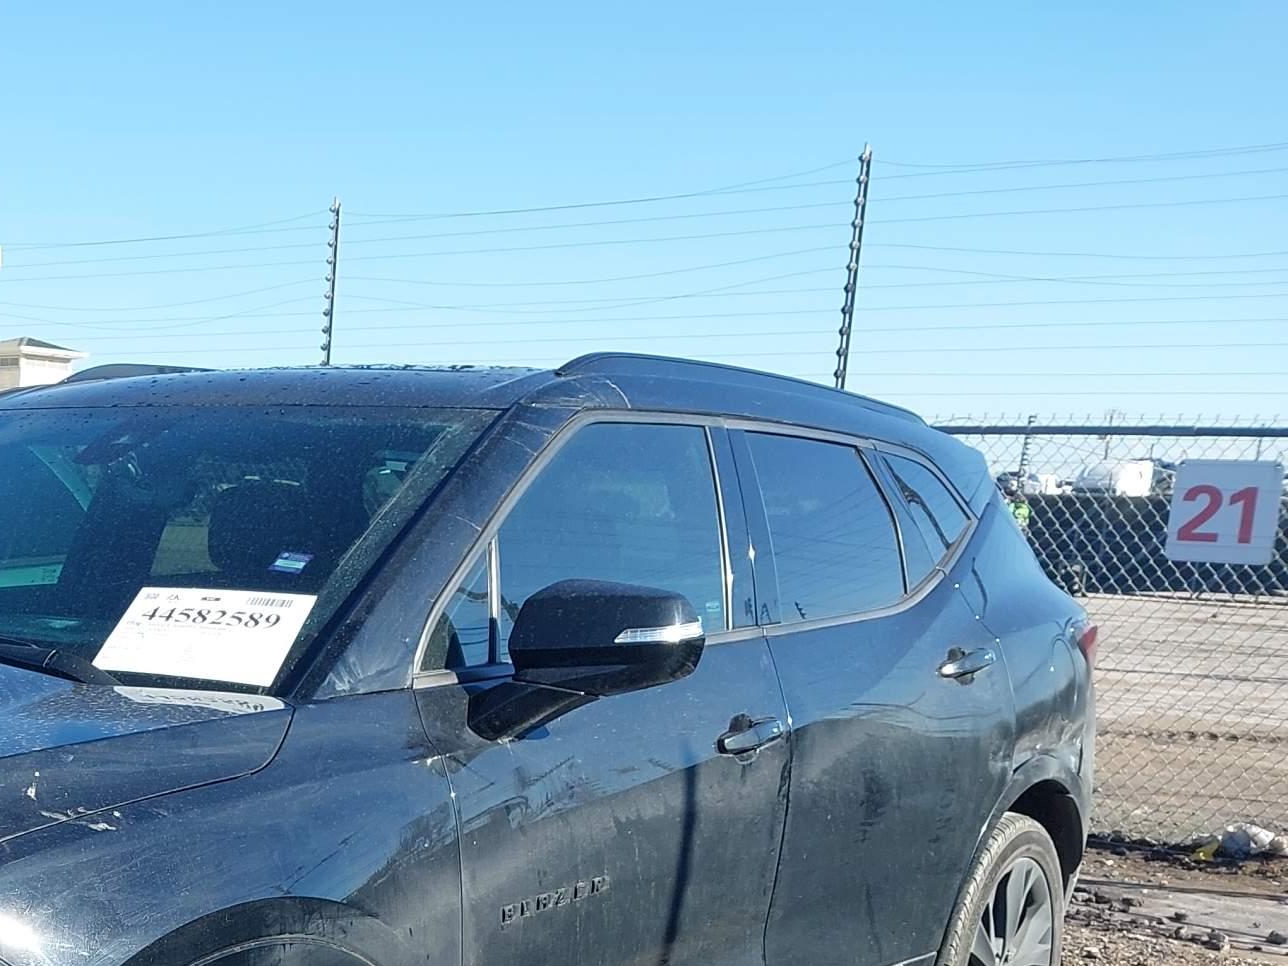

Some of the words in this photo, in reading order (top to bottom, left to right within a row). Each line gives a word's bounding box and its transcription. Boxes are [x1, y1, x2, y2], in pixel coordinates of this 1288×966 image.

[1176, 484, 1260, 544] 21
[141, 605, 281, 629] 44582589
[500, 875, 610, 924] BLAZER
